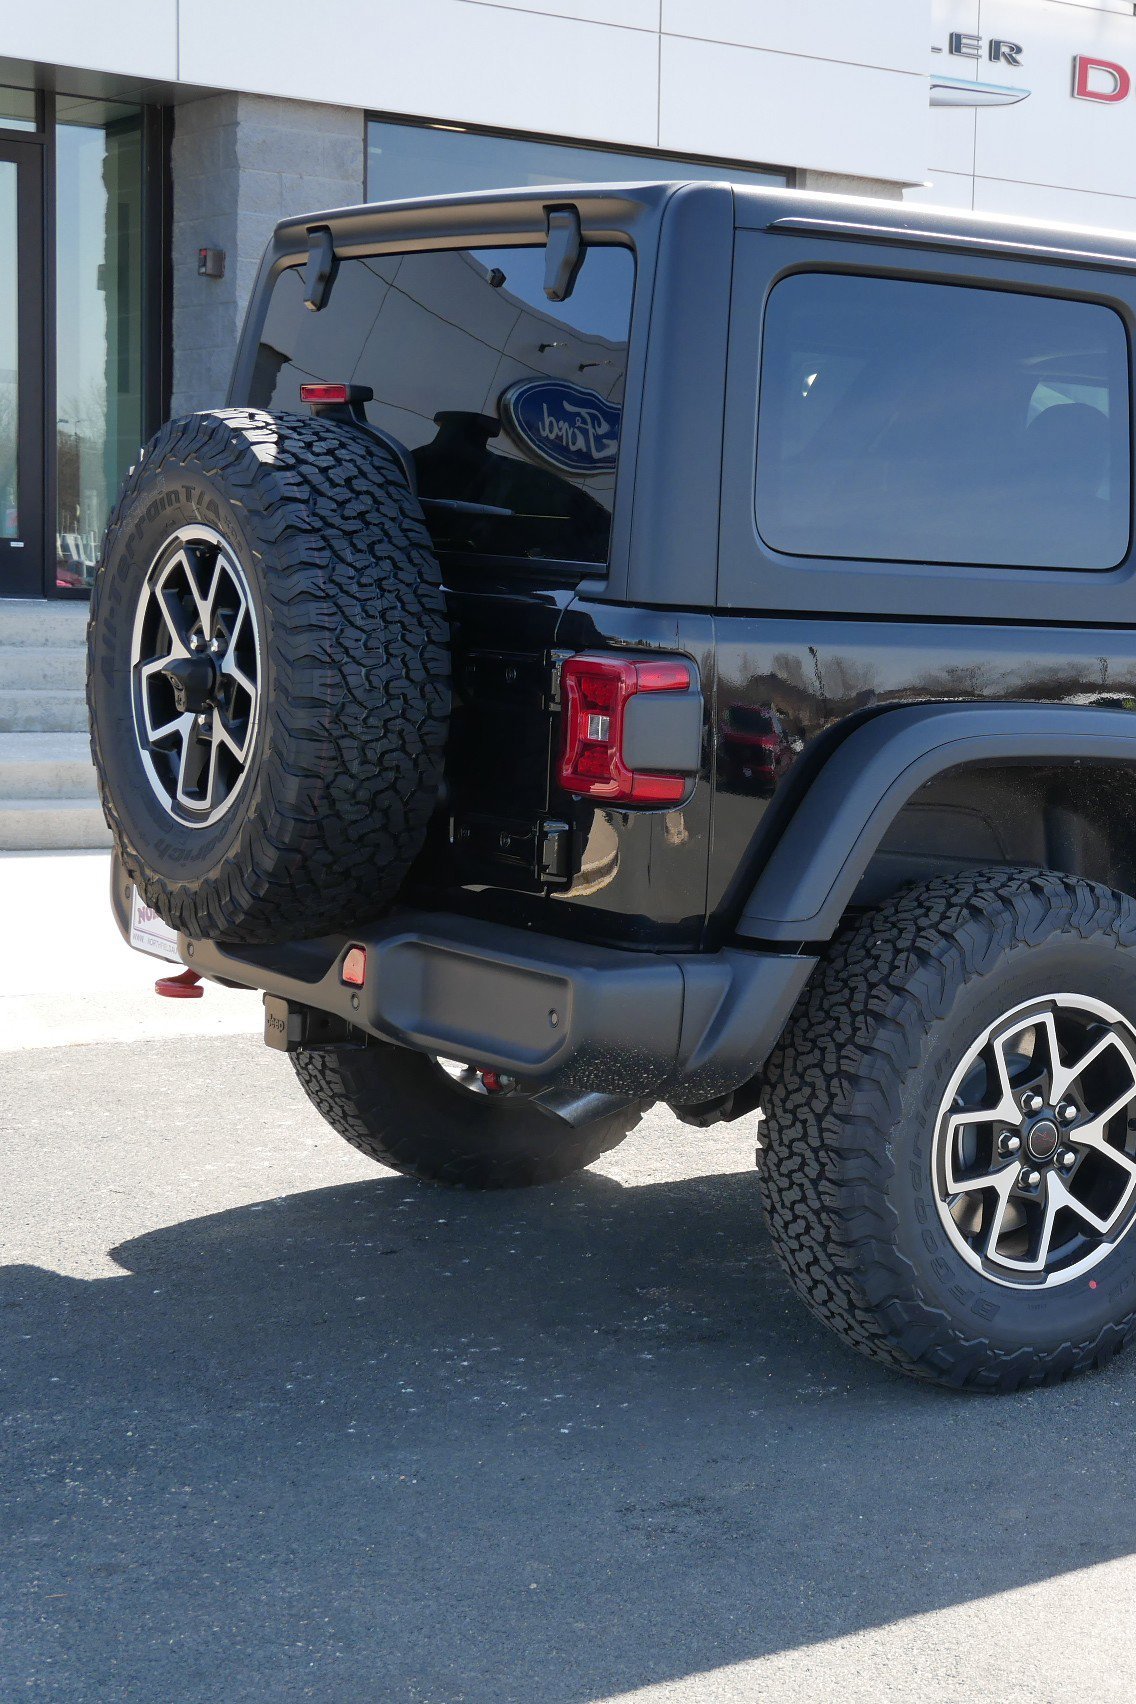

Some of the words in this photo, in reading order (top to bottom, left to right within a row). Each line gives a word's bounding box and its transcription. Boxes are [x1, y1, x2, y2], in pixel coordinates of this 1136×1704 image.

[931, 31, 1023, 66] ER
[267, 1013, 285, 1033] Jeep
[908, 1048, 1001, 1322] BFGoodrich
